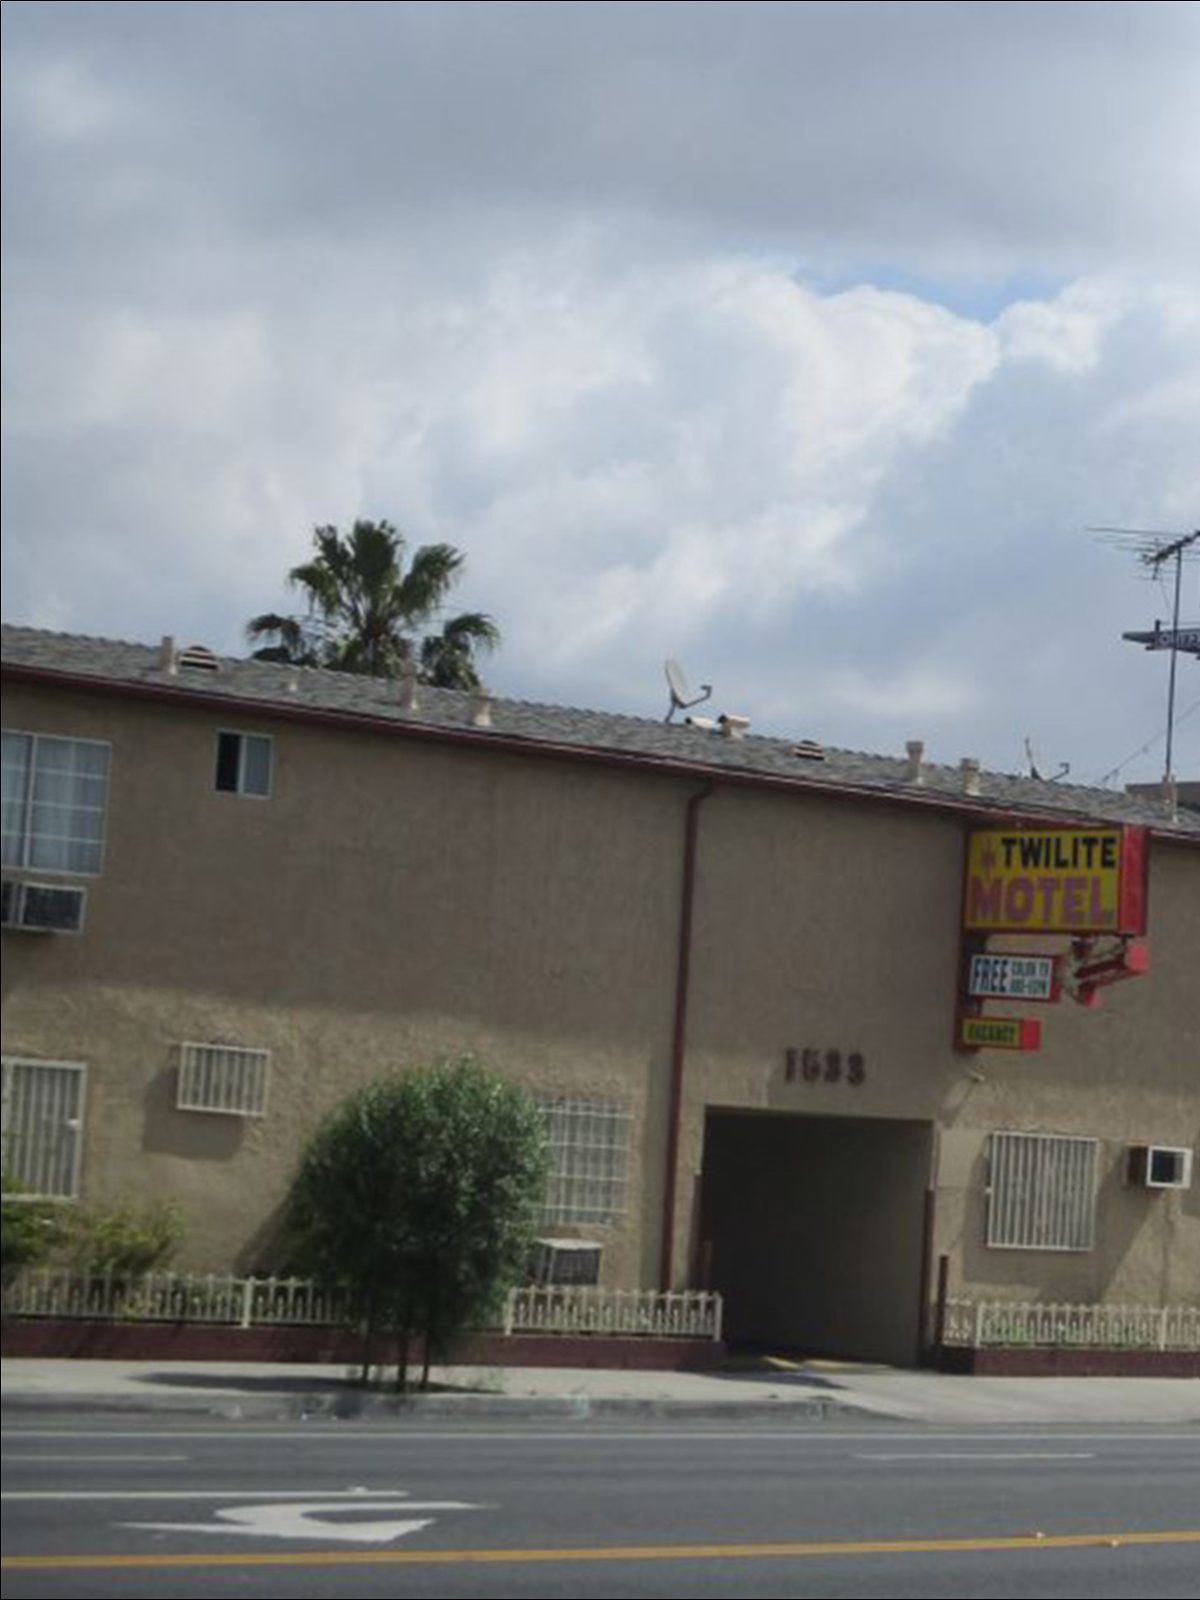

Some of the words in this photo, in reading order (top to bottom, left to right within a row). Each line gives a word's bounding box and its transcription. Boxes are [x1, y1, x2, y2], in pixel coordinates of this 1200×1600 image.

[1001, 837, 1117, 869] TWILITE
[969, 875, 1114, 924] MOTEL
[971, 958, 1009, 993] FREE
[968, 1022, 1016, 1043] VACANCY
